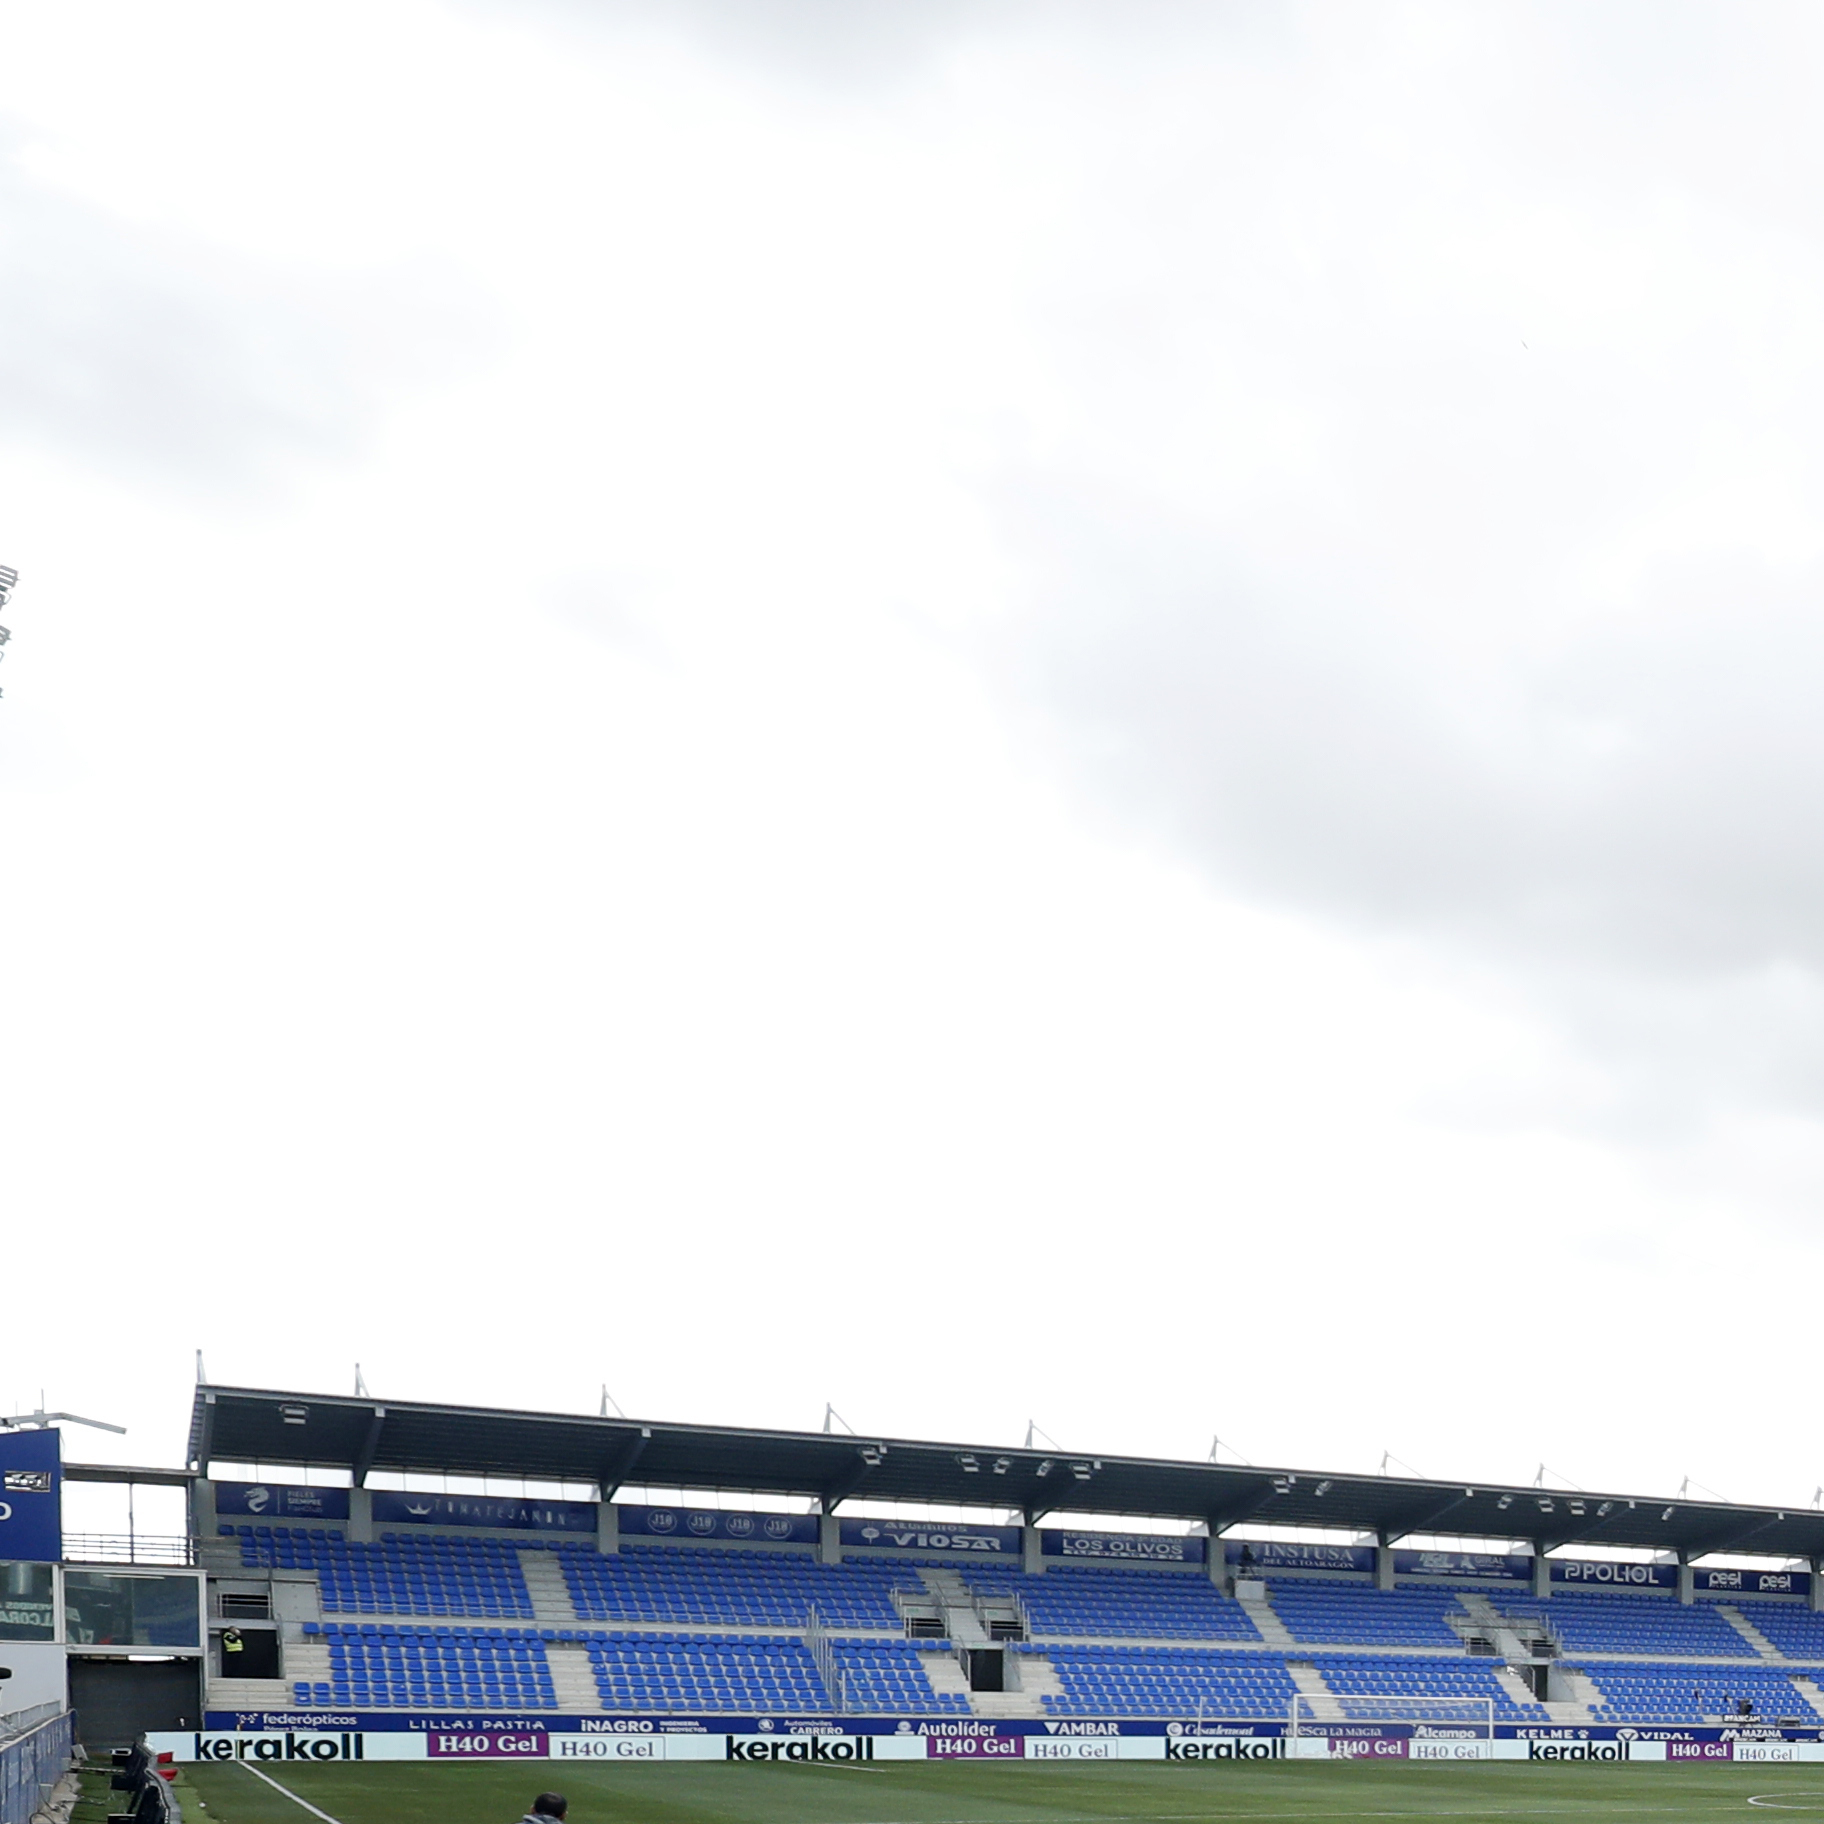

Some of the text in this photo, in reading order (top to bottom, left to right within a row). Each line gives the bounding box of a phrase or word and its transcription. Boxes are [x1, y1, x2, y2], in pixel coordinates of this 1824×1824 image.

[1063, 1538, 1184, 1554] LOS OLIVOS
[1263, 1543, 1354, 1562] INSTUSA
[263, 1713, 358, 1727] federópticos
[409, 1719, 546, 1730] LILLAS PASTIA
[789, 1726, 844, 1735] CABRERO
[917, 1721, 997, 1736] Autolíder
[1058, 1722, 1120, 1735] AMBAR
[1414, 1725, 1477, 1739] Alcampo
[1516, 1729, 1574, 1739] KELME
[1640, 1731, 1694, 1741] VIDAL
[194, 1732, 364, 1760] kerakoll
[438, 1735, 539, 1752] H40 Gel
[560, 1741, 655, 1757] H40 Gel
[726, 1735, 874, 1760] kerakoll
[935, 1738, 1016, 1754] H40 Gel
[1032, 1743, 1109, 1758] H40 Gel
[1165, 1737, 1286, 1760] kerakoll
[1335, 1740, 1403, 1755] H40 Gel
[1529, 1740, 1630, 1761] kerakoll
[1672, 1742, 1728, 1757] H40 Gel
[1416, 1744, 1481, 1759] H40 Gel
[1739, 1747, 1793, 1761] H40 Gel
